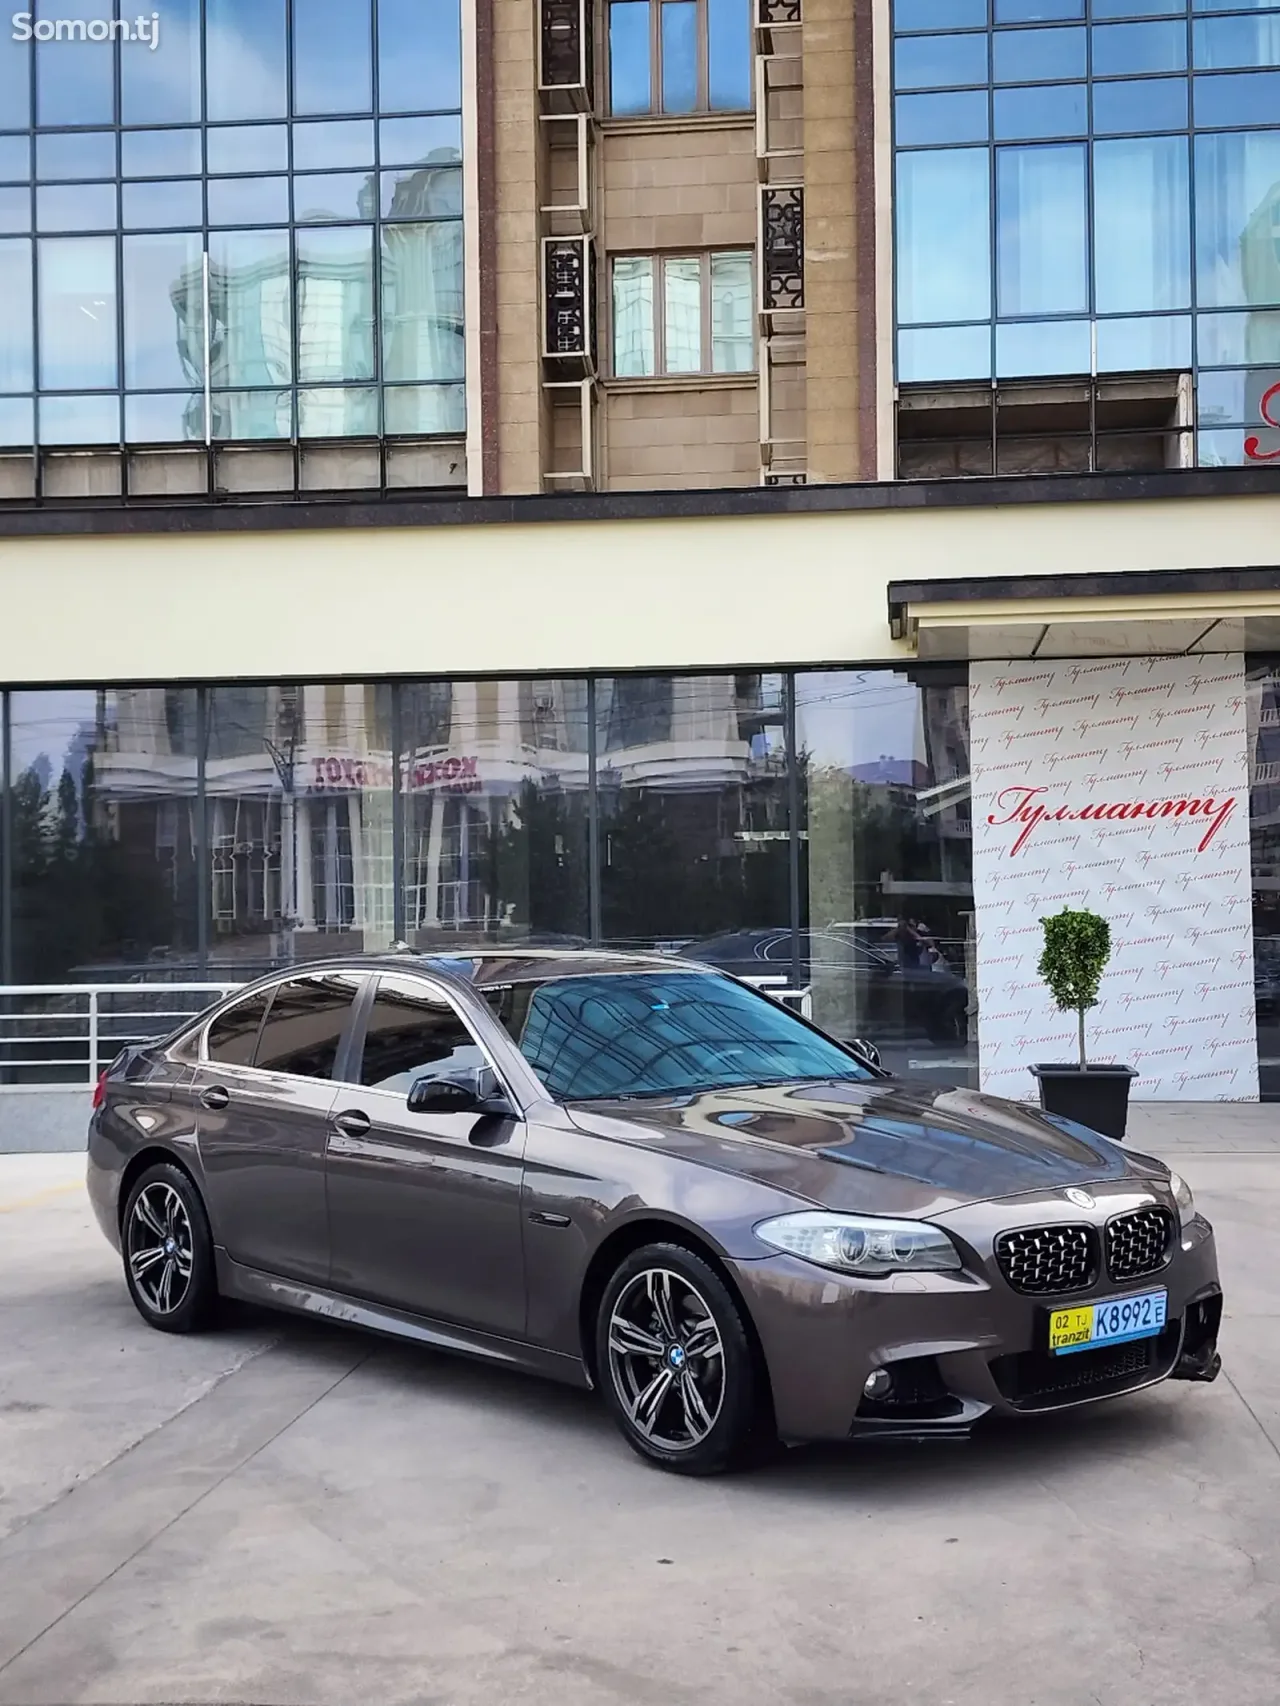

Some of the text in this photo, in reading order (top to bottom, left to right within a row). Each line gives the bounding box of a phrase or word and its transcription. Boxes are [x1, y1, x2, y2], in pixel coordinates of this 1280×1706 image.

[988, 786, 1238, 857] Гулманту
[1055, 1314, 1088, 1329] 02 TJ
[1096, 1298, 1151, 1336] K8992
[1052, 1328, 1090, 1346] tranzit
